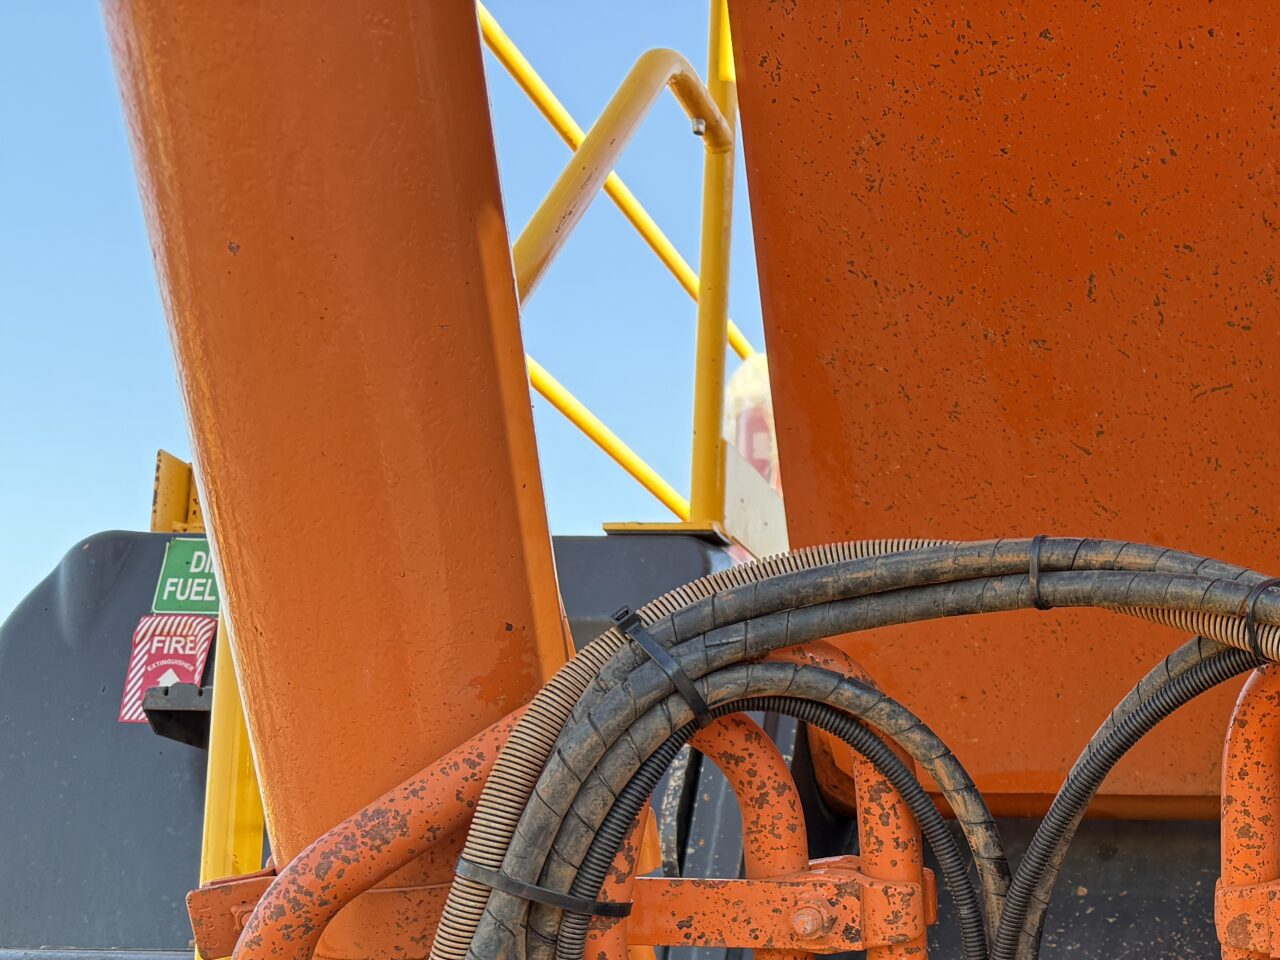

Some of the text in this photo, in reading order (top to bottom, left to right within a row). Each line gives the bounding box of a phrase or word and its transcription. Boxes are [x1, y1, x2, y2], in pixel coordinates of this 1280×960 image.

[163, 579, 216, 601] FUEL
[150, 636, 198, 655] FIRE
[147, 659, 195, 672] EXTINGUISHER
